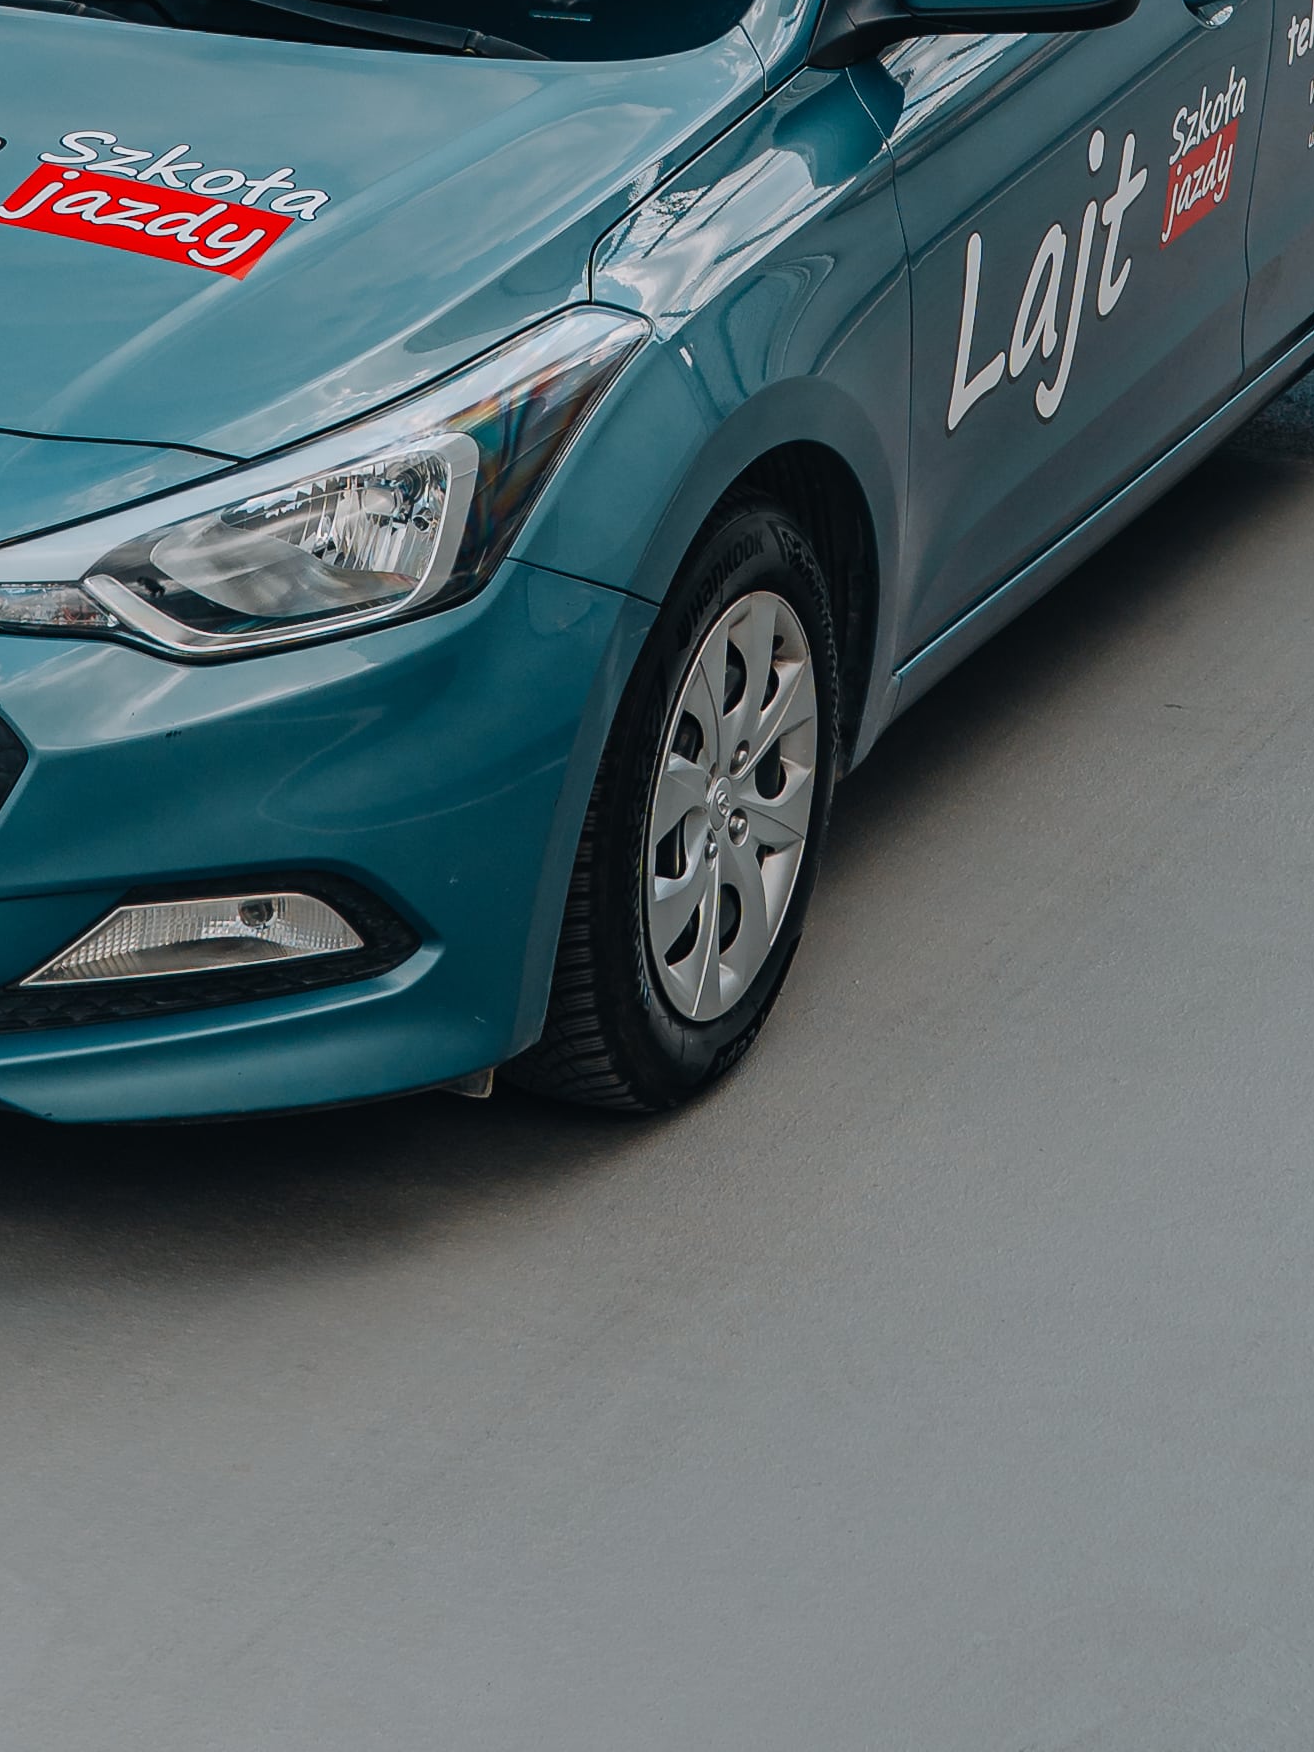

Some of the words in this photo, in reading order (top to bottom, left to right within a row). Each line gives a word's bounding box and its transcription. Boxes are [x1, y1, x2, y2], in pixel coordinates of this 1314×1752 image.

[1169, 65, 1246, 166] Szkoła
[38, 130, 331, 221] Szkoła
[1161, 133, 1234, 243] jazdy
[947, 129, 1148, 431] Lajt
